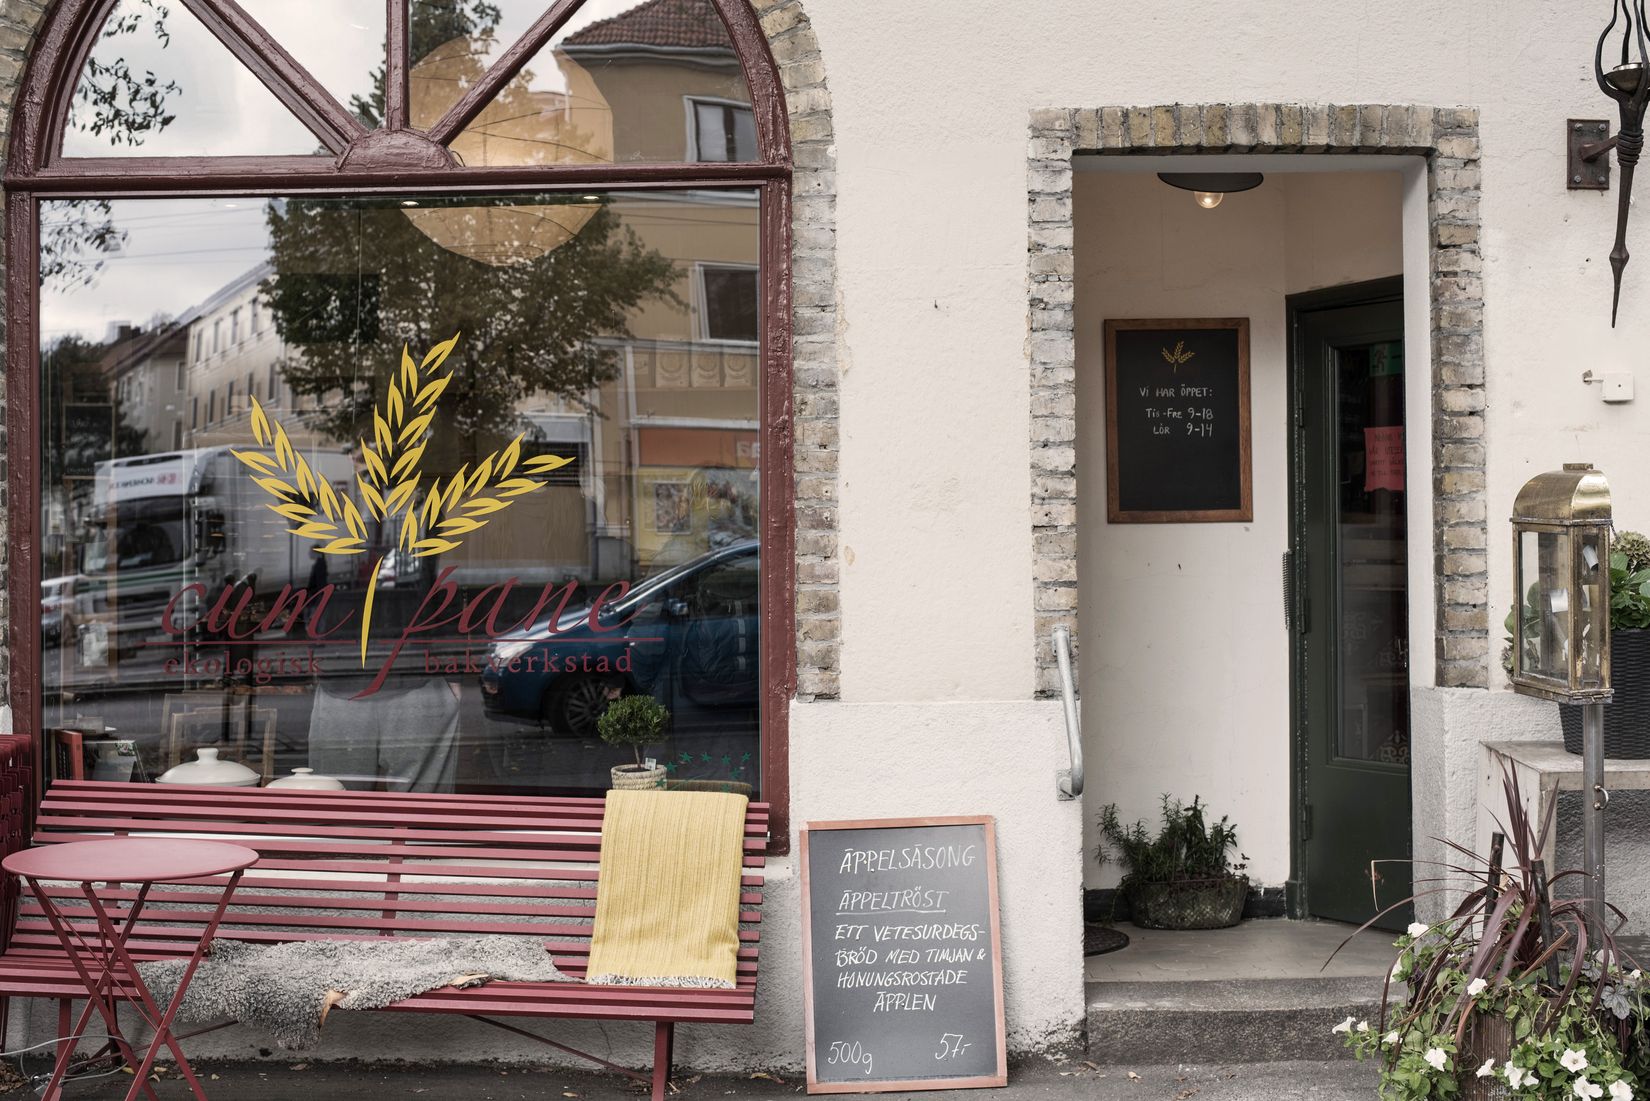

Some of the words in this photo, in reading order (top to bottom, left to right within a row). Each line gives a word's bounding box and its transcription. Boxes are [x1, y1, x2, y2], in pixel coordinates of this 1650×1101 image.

[1156, 387, 1175, 397] HAR
[1180, 384, 1213, 397] ÖPPET:
[1187, 407, 1213, 420] 9-18
[1186, 423, 1213, 437] 9-14
[161, 582, 355, 640] cum
[349, 565, 643, 701] pane
[163, 648, 325, 684] ekologisk
[425, 647, 633, 674] bakverkstad
[835, 924, 869, 940] ETT
[873, 924, 986, 942] VETESURDEGS-
[835, 946, 877, 967] BRÖD
[885, 949, 920, 964] MED
[925, 948, 973, 963] TIMJAN
[976, 950, 986, 961] &
[837, 969, 968, 988] HONUNGSROSTADE
[827, 1040, 873, 1075] 500g
